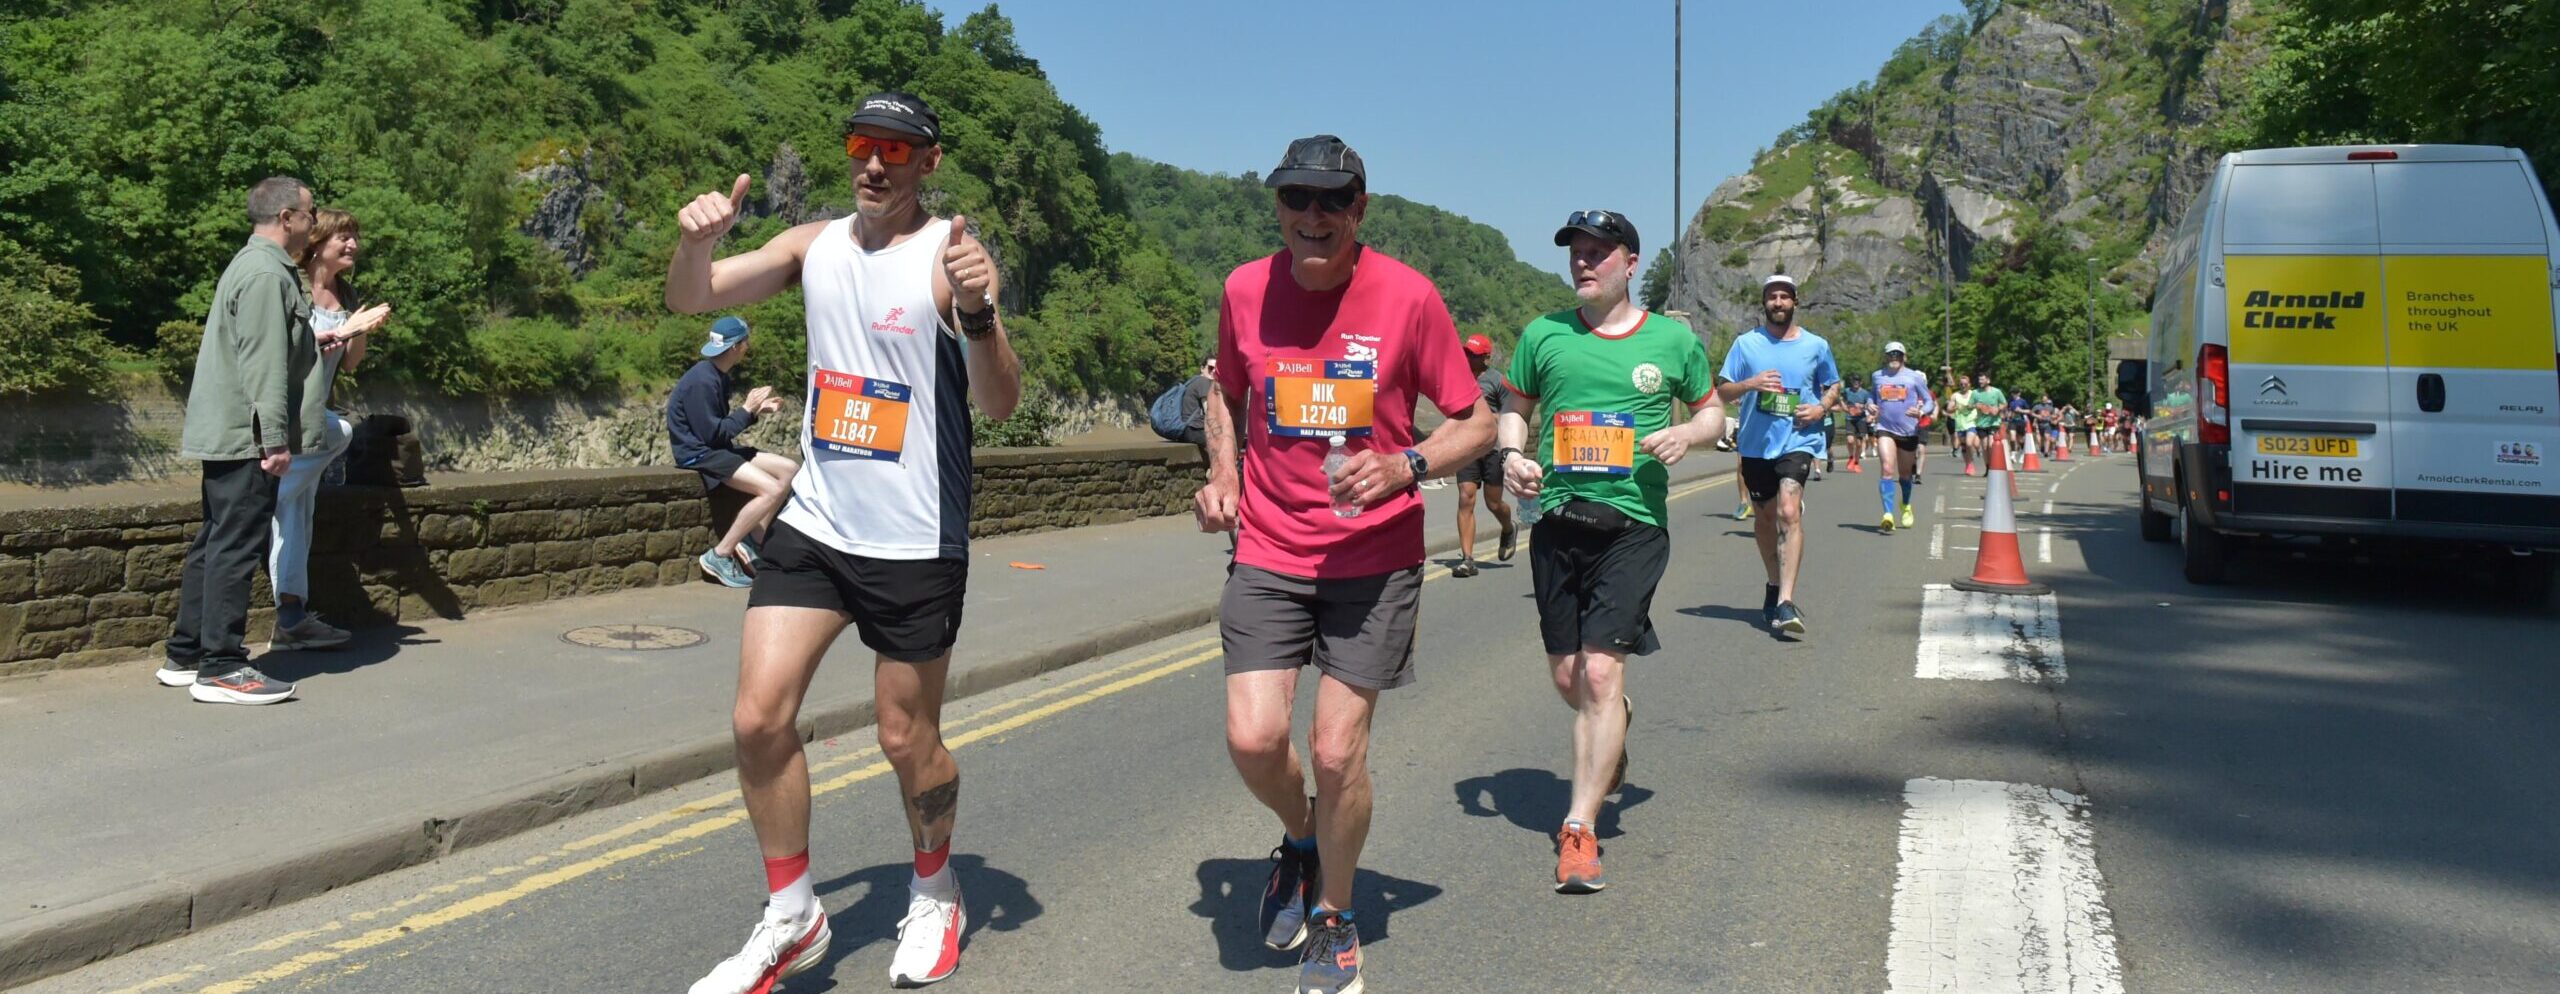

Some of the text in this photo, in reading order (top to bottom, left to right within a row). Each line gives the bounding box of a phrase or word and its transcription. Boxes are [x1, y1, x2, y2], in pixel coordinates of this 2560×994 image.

[2244, 290, 2365, 309] Arnold
[2406, 291, 2475, 302] Branches
[2407, 306, 2491, 318] throughout
[871, 321, 915, 335] RunFinder
[2244, 311, 2336, 330] Clark
[2408, 321, 2458, 332] the UK
[1355, 334, 1381, 342] Together
[1312, 383, 1335, 402] NIK
[844, 399, 871, 420] BEN
[1300, 404, 1347, 424] 12740
[2499, 405, 2544, 414] RELAY
[830, 418, 877, 444] 11847
[1562, 427, 1624, 442] GRAHAM
[841, 445, 873, 457] MARATHON
[2314, 438, 2350, 453] UFD
[1572, 447, 1609, 462] 13817
[2252, 460, 2363, 483] Hire me
[2417, 474, 2542, 487] ArnoldClarkRental.com
